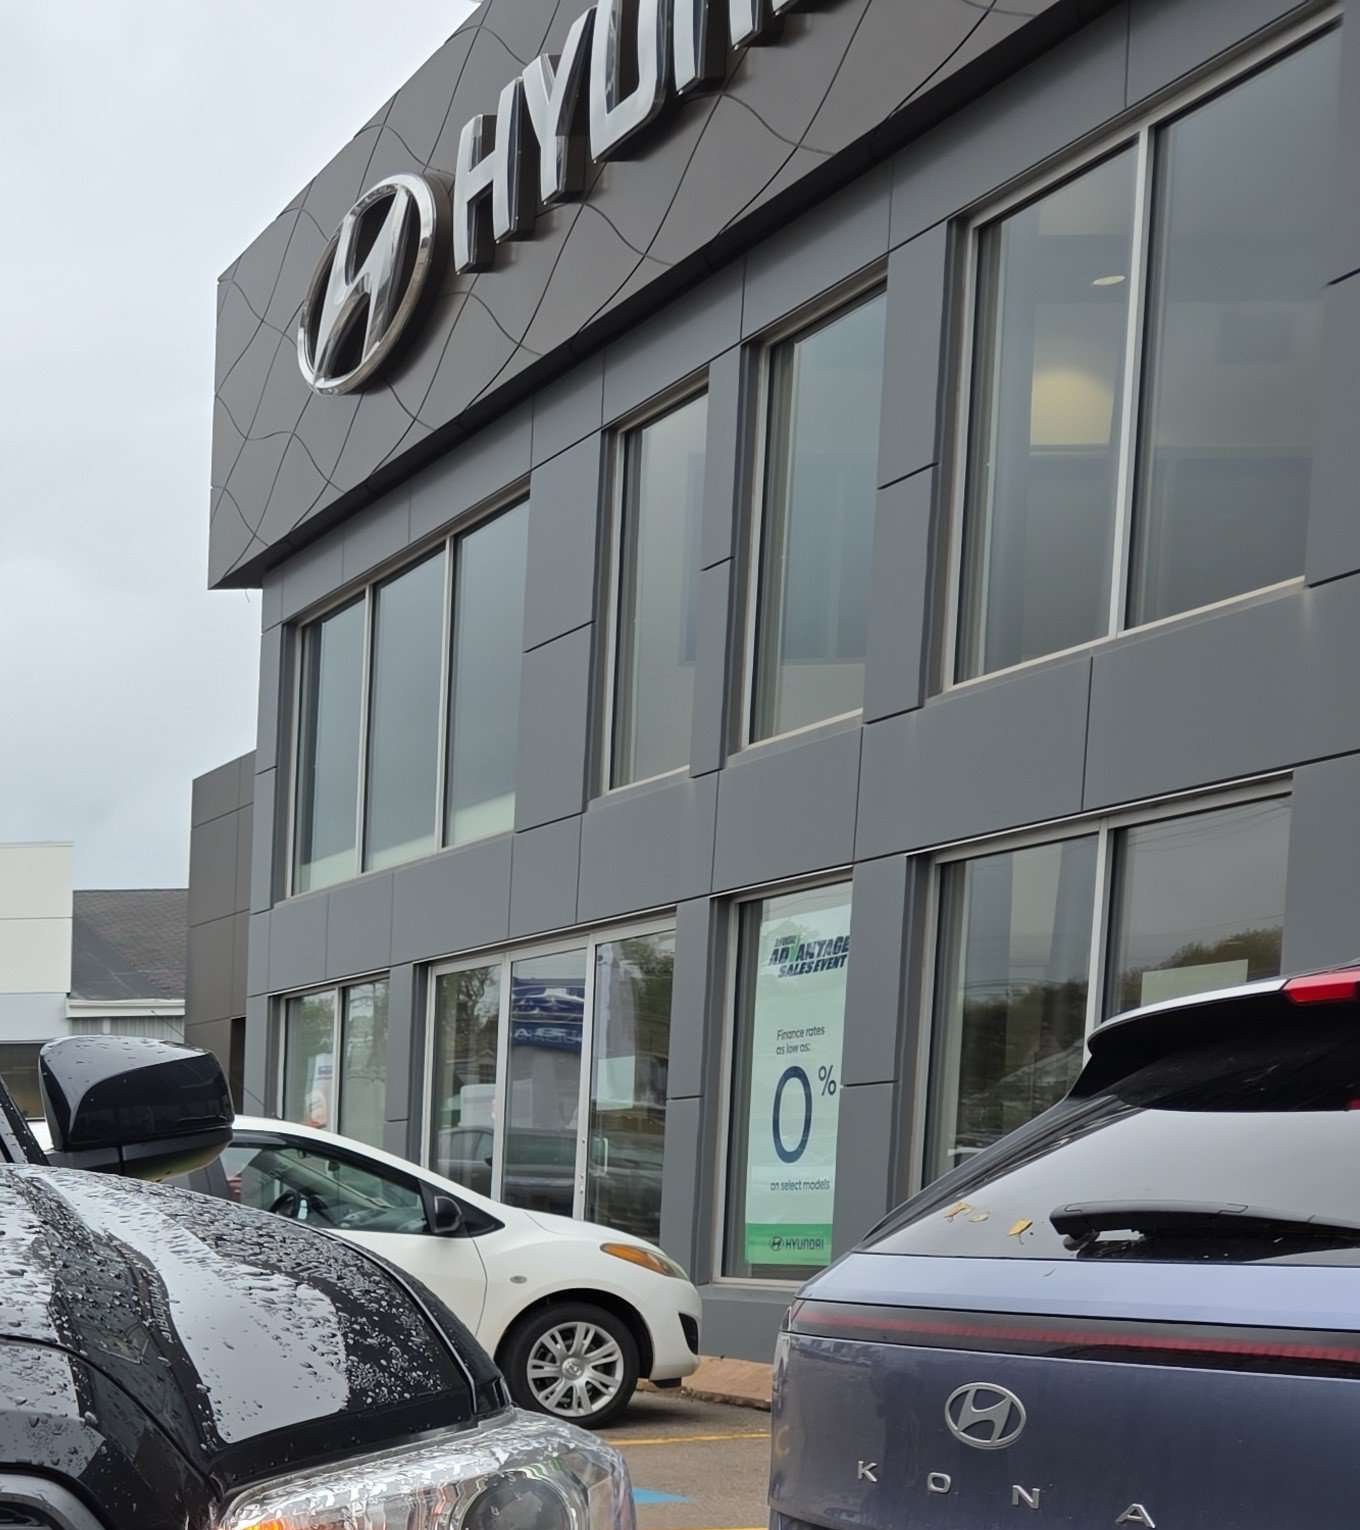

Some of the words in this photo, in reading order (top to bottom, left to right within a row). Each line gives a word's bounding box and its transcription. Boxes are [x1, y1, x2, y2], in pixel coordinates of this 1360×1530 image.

[768, 935, 850, 966] ADVANTAGE
[778, 961, 815, 978] SALES
[812, 954, 848, 973] EVENT
[776, 1029, 804, 1041] Finance
[805, 1026, 825, 1037] rates
[772, 1065, 813, 1164] 0
[770, 1181, 780, 1192] on
[781, 1180, 802, 1191] select
[803, 1179, 830, 1191] models
[786, 1238, 825, 1250] HYUNDAI
[857, 1461, 1156, 1529] KONA
